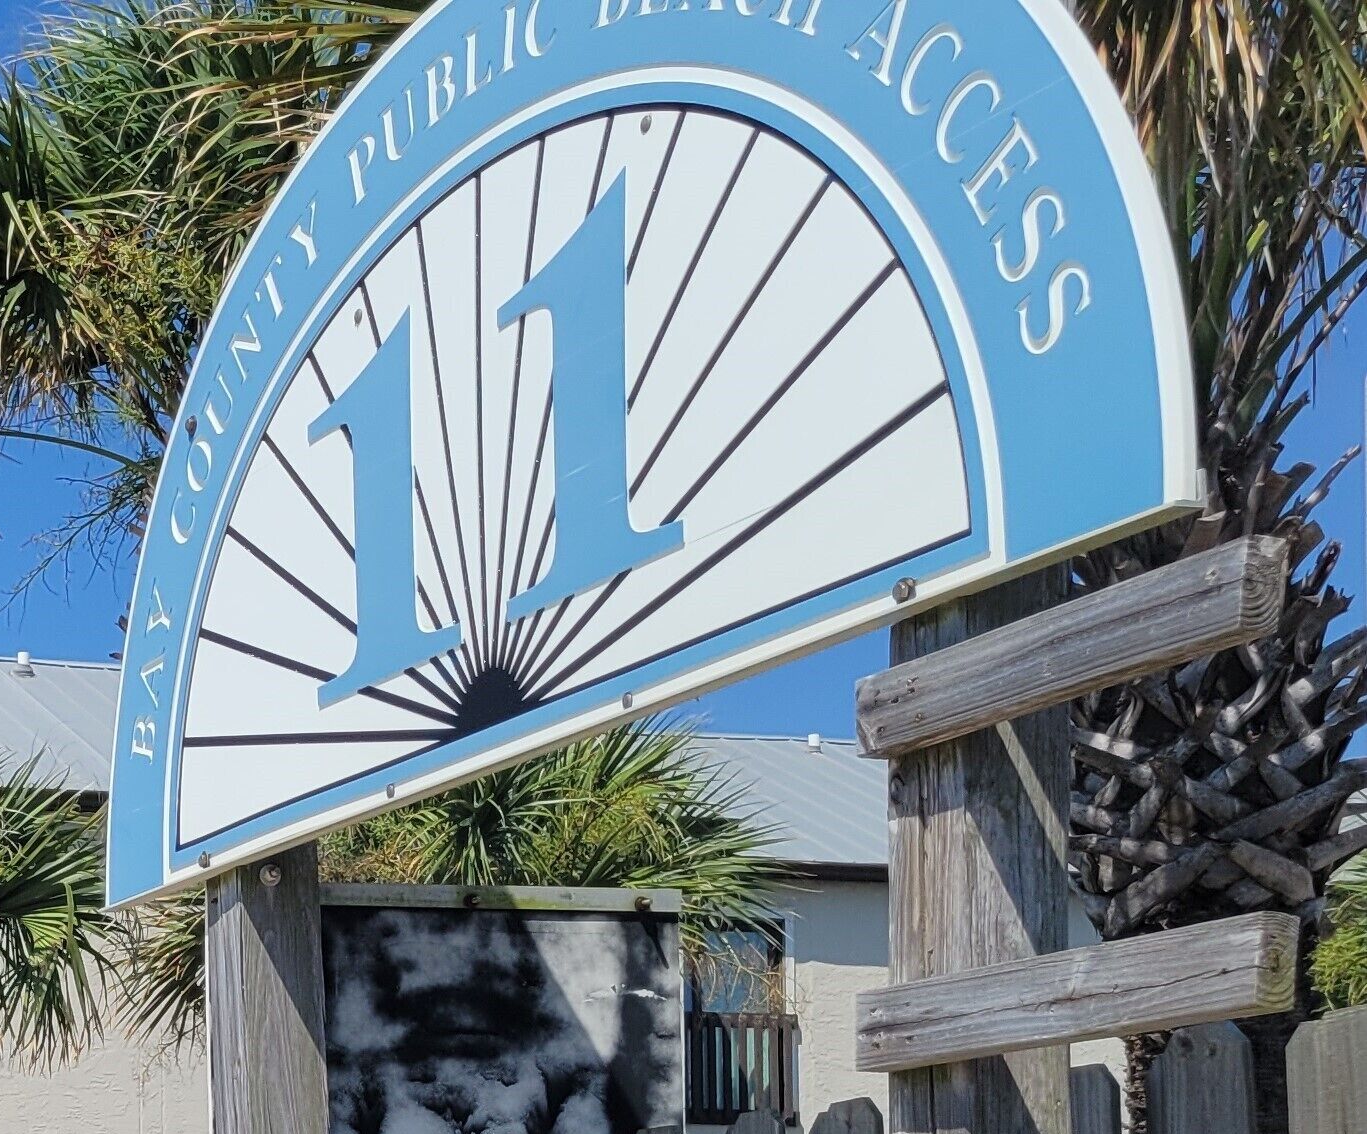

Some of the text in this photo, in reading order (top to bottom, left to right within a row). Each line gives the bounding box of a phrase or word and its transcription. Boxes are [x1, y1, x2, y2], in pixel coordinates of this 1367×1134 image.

[131, 0, 1091, 765] BAY COUNTY PUBLIC ACCESS
[307, 166, 682, 708] 11
